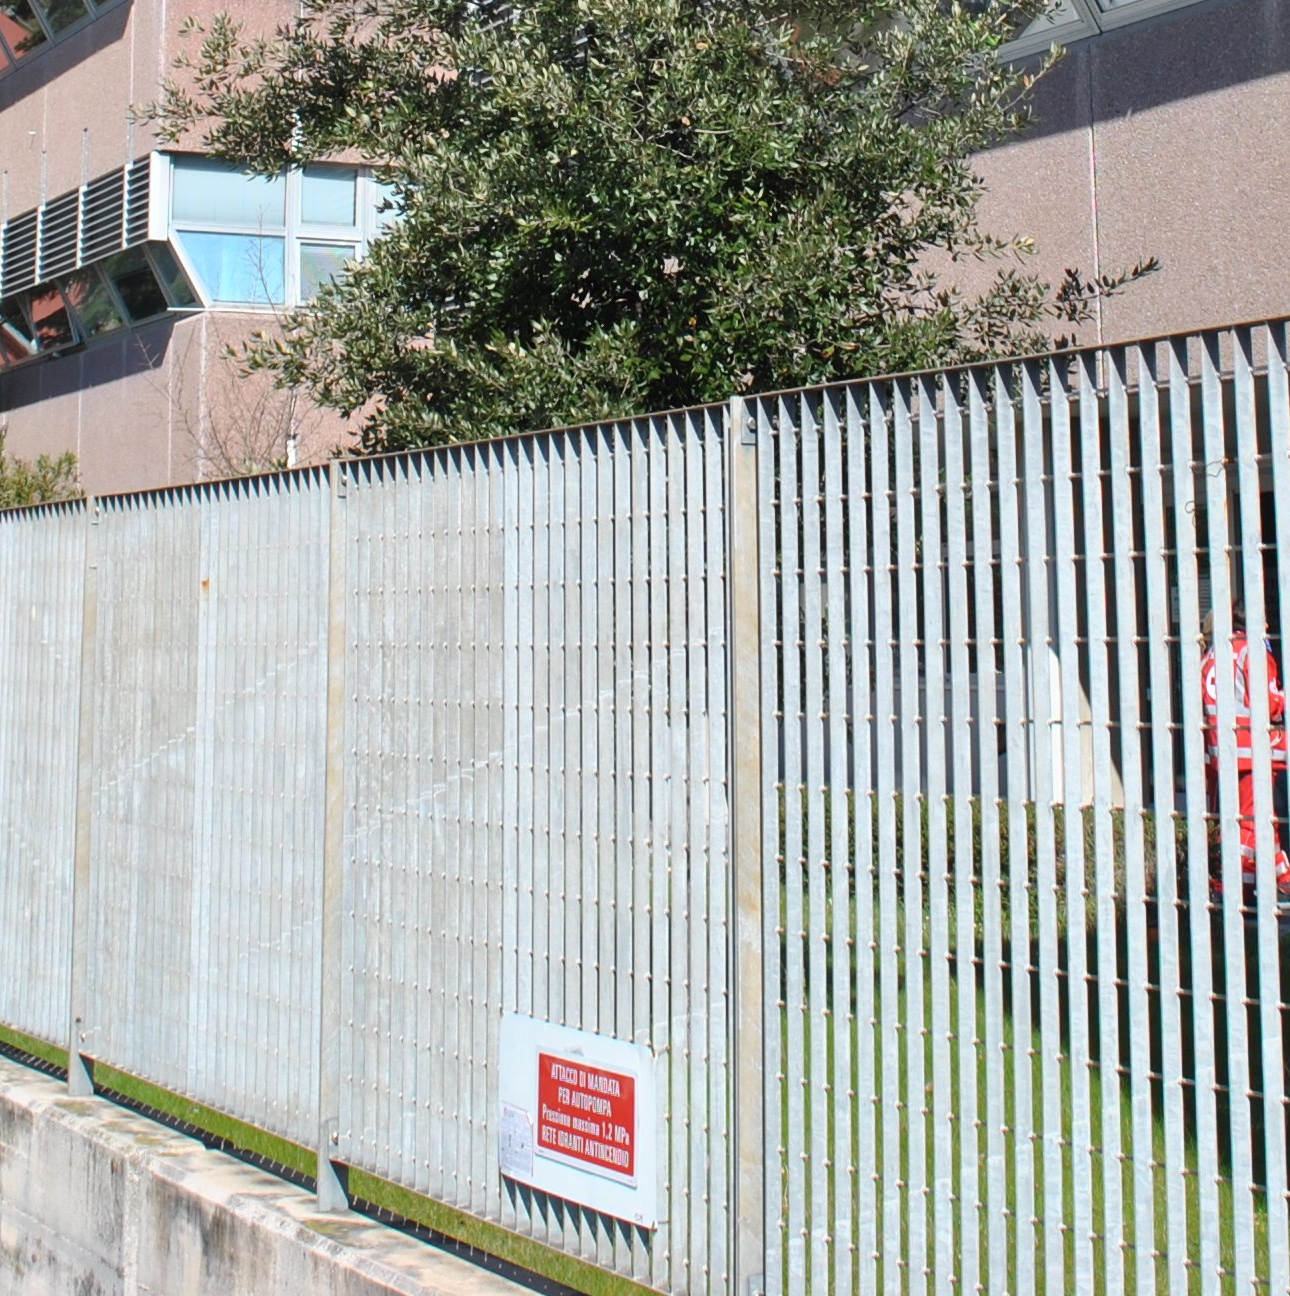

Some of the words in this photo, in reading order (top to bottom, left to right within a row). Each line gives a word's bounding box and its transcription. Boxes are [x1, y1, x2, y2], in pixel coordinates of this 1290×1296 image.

[551, 1063, 577, 1086] ATTACCO
[579, 1071, 586, 1088] DI
[587, 1073, 620, 1098] MANDATA
[558, 1086, 570, 1106] PER
[571, 1091, 612, 1117] AUTOPOMPA
[542, 1103, 571, 1126] Pressione
[572, 1116, 599, 1136] massima
[614, 1124, 630, 1146] MPa
[541, 1125, 556, 1145] RETE
[557, 1130, 583, 1153] IDRANTI
[584, 1139, 629, 1168] ANTINCENDIO
